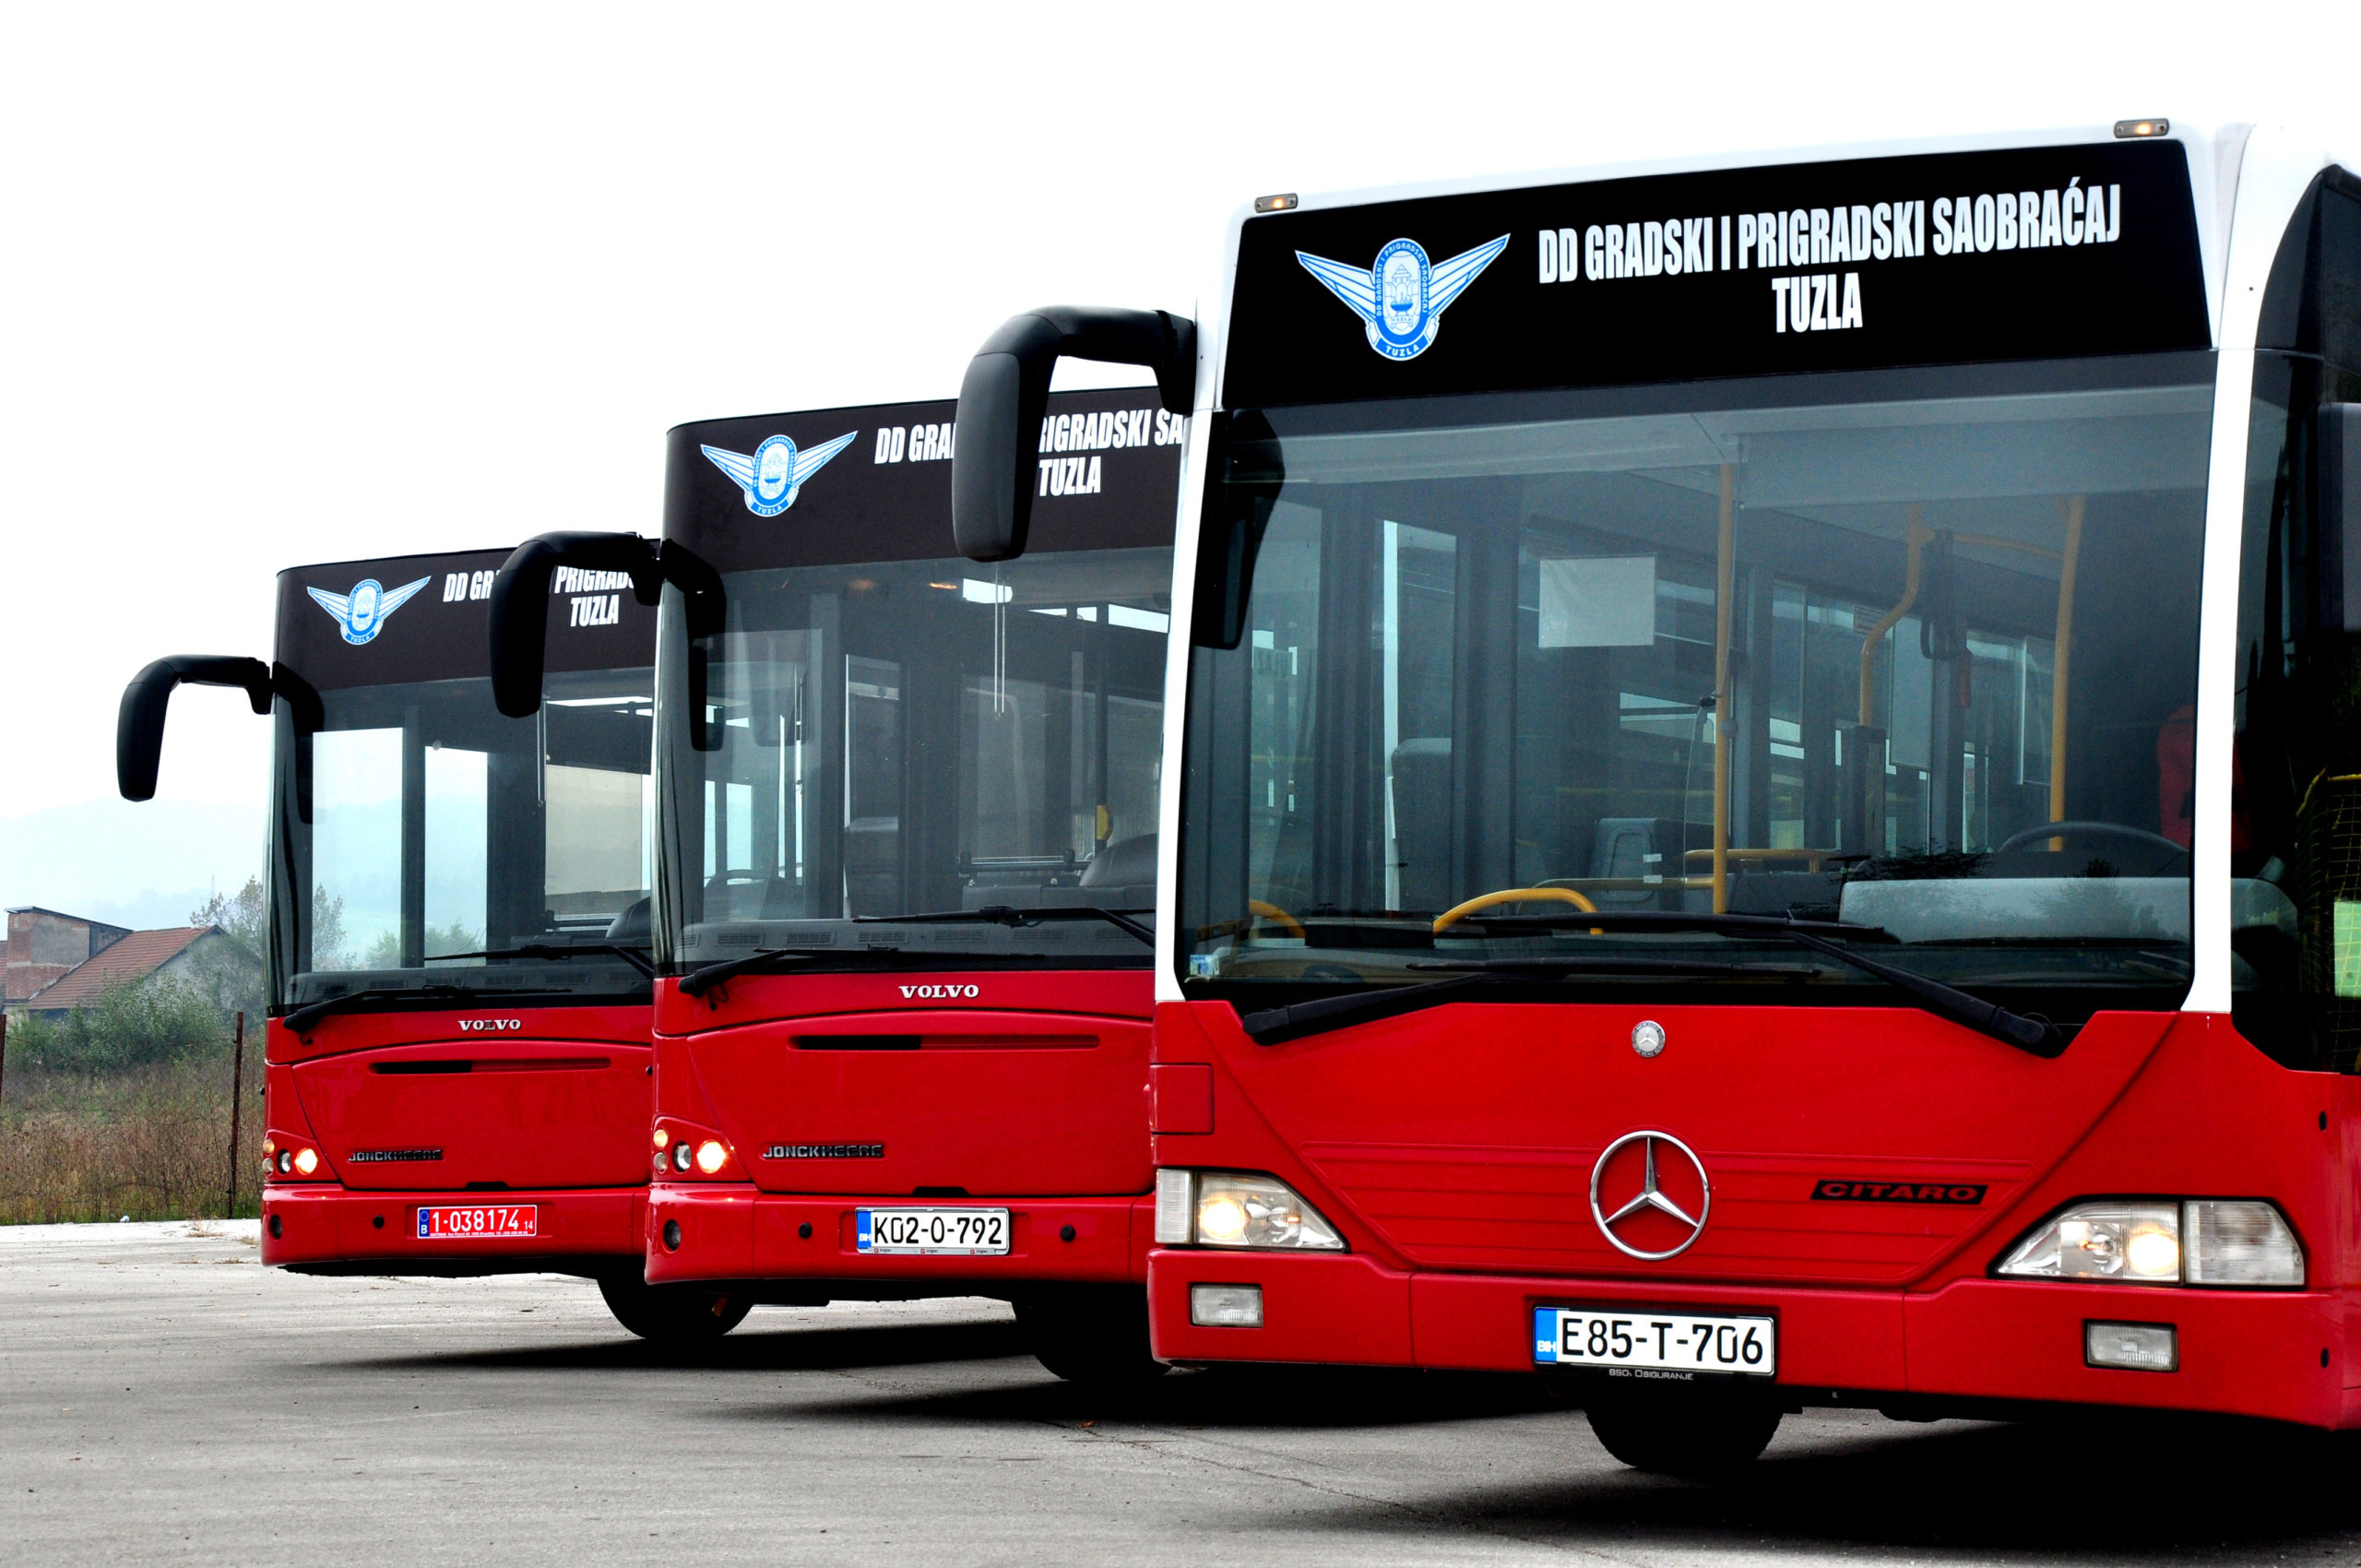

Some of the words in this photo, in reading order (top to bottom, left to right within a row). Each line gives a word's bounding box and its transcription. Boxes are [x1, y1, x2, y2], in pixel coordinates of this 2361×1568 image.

[1539, 228, 1578, 283] DD
[1585, 217, 1714, 281] GRADSKI
[1721, 215, 1731, 270] I
[1739, 200, 1925, 270] PRIGRADSKI
[1933, 177, 2120, 255] SAOBRAĆAJ
[1772, 273, 1863, 333] TUZLA
[1385, 344, 1420, 357] TUZLA
[873, 427, 906, 464] DD
[1038, 456, 1101, 497] TUZLA
[757, 505, 782, 514] TUZLA
[443, 573, 469, 602] DD
[469, 569, 501, 600] GR
[570, 594, 620, 627] TUZLA
[898, 984, 979, 999] VOLVO
[457, 1018, 521, 1031] VOLVO
[762, 1145, 884, 1158] JONCKHEERE
[1821, 1182, 1978, 1201] CITARO
[421, 1224, 428, 1234] B
[432, 1208, 519, 1232] 1-038174
[524, 1220, 533, 1230] 14
[1561, 1317, 1763, 1365] E85-T-706
